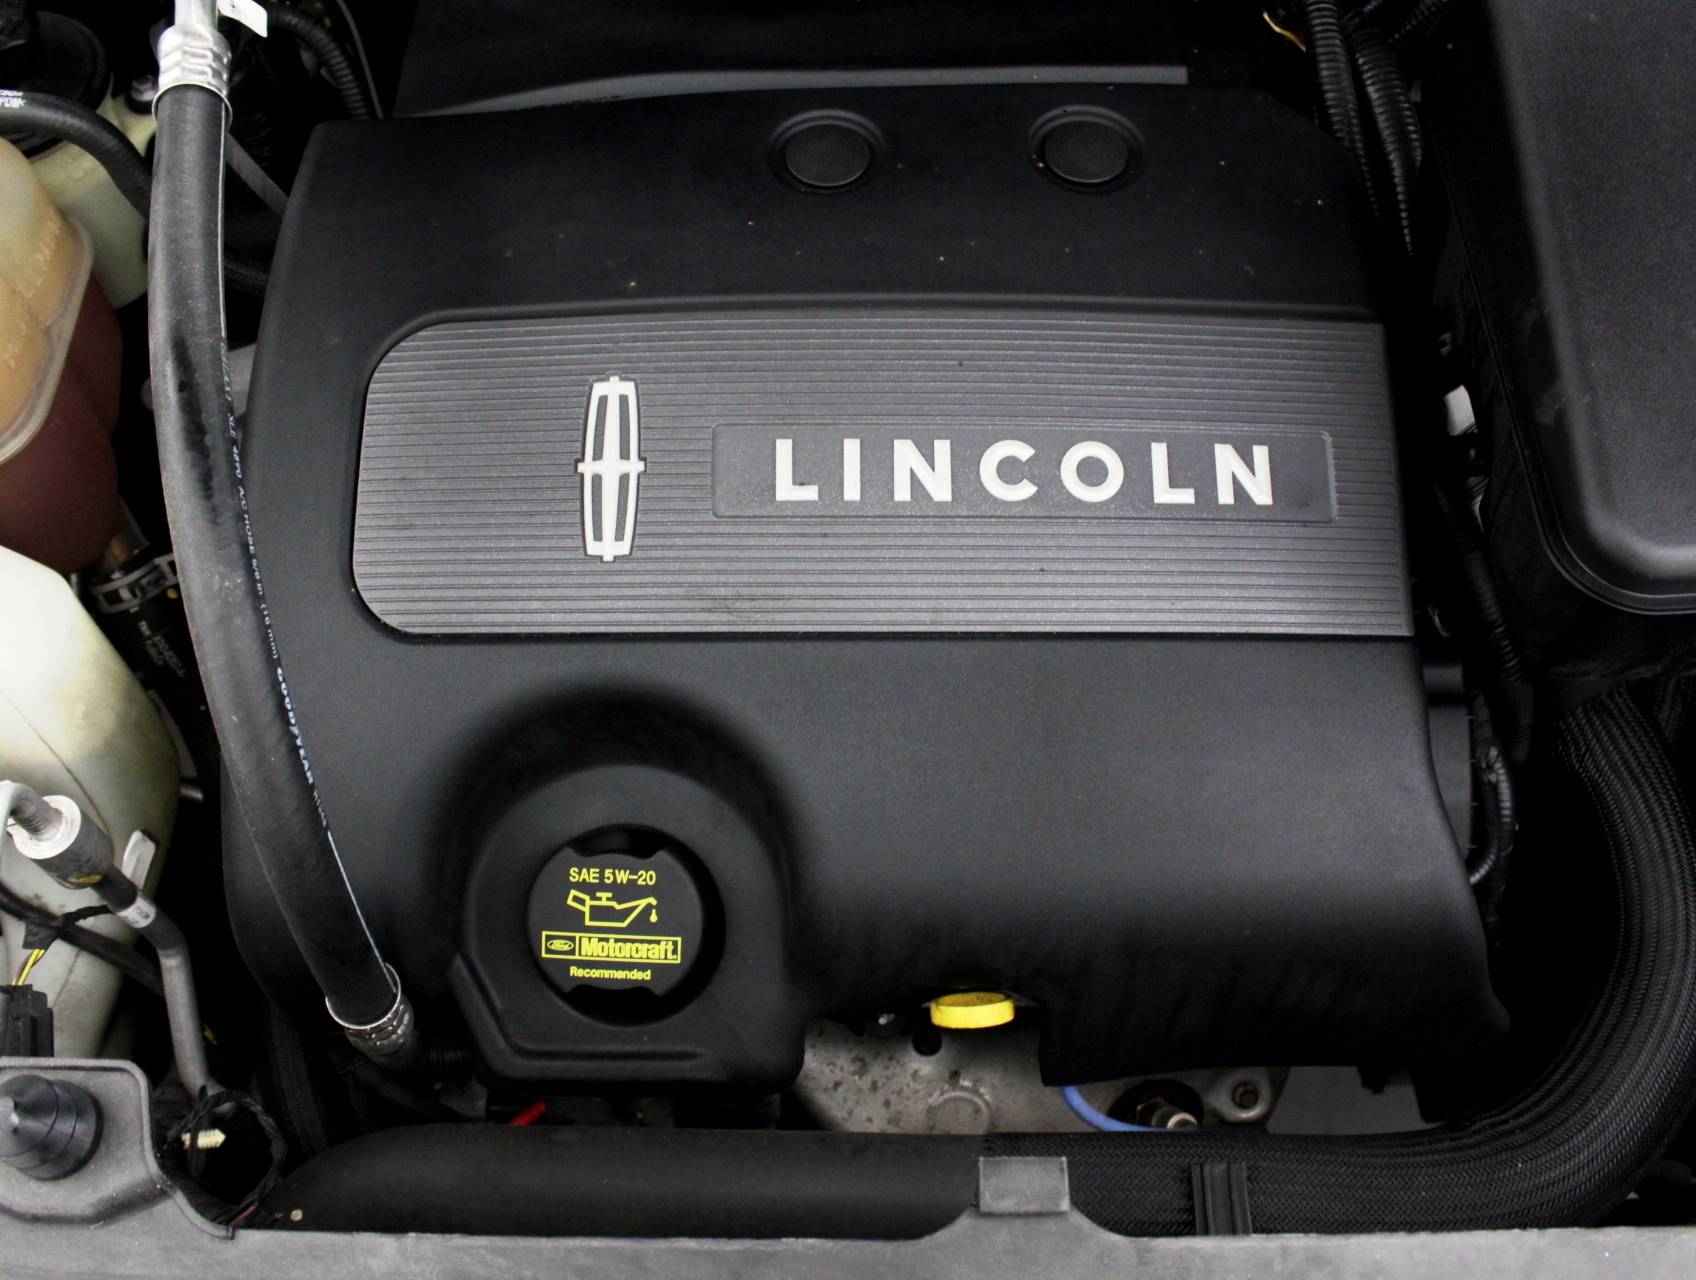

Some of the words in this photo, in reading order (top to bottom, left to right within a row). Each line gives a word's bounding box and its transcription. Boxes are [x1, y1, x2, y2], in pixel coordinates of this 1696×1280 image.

[775, 438, 1273, 506] LINCOLN
[243, 513, 255, 554] HOSE
[569, 867, 599, 883] SAE
[604, 869, 656, 885] 5W-20
[570, 966, 651, 980] Recommended
